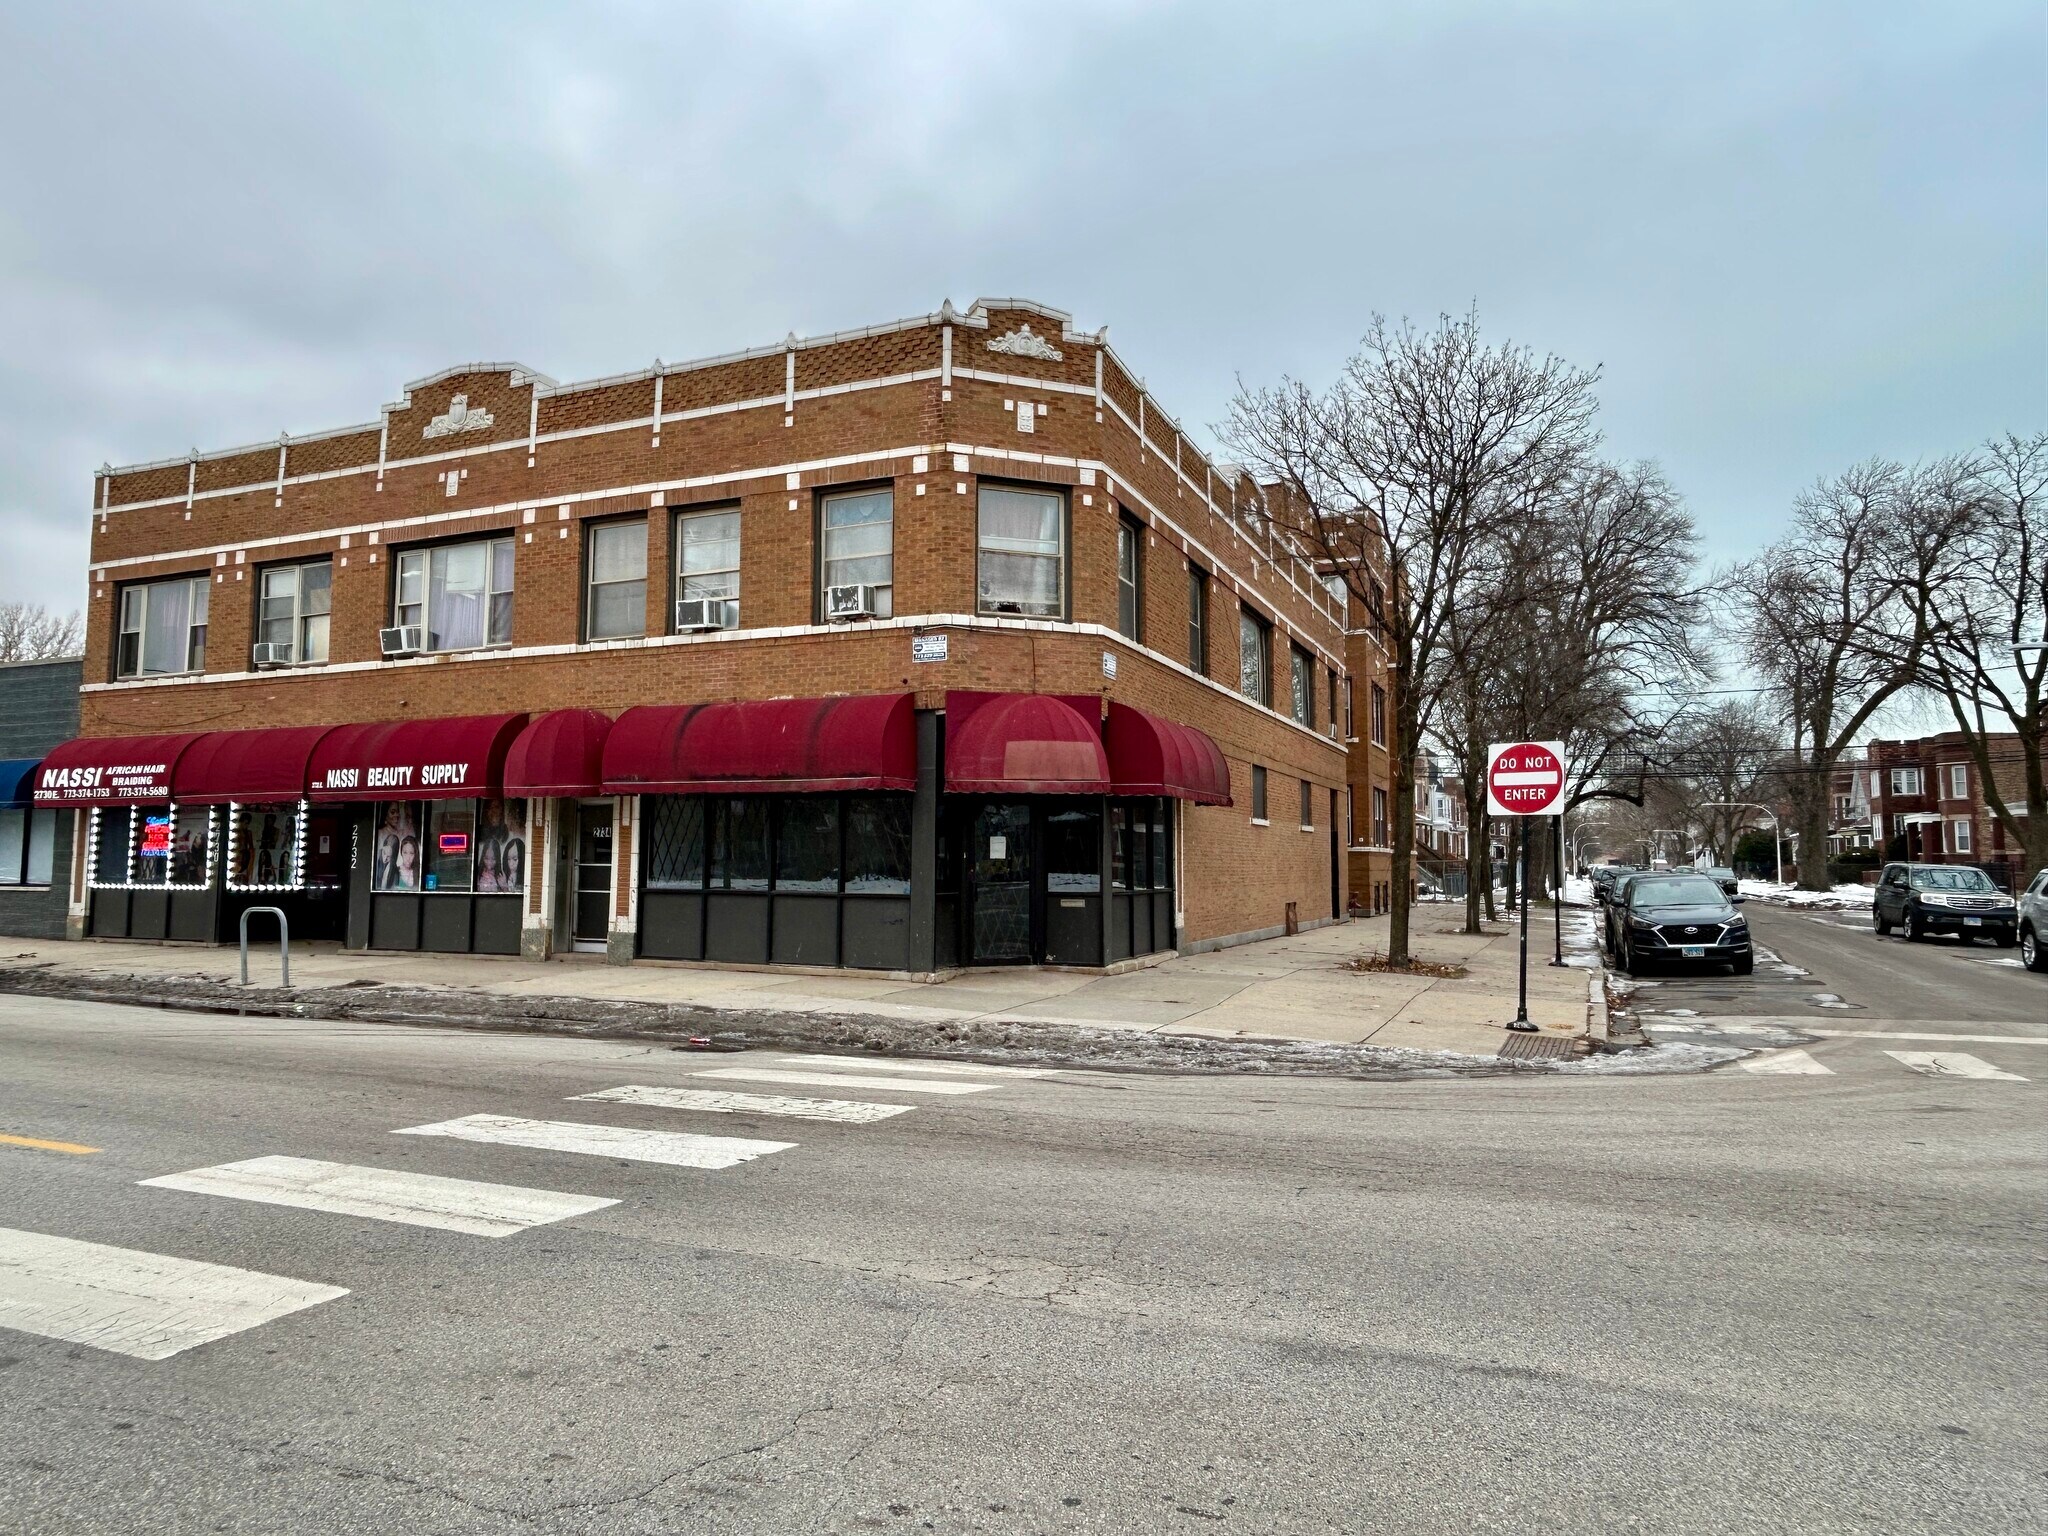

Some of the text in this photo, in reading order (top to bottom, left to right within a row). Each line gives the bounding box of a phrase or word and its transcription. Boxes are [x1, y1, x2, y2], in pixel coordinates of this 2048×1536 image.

[1500, 757, 1551, 769] DO NOT
[105, 764, 166, 775] AFRICAN HAIR
[326, 763, 468, 788] NASSI BEAUTY SUPPLY
[42, 767, 103, 788] NASSI
[112, 776, 153, 786] BRAIDING
[63, 788, 110, 798] 773-374-1753
[1504, 788, 1546, 800] ENTER
[350, 824, 358, 869] 2732
